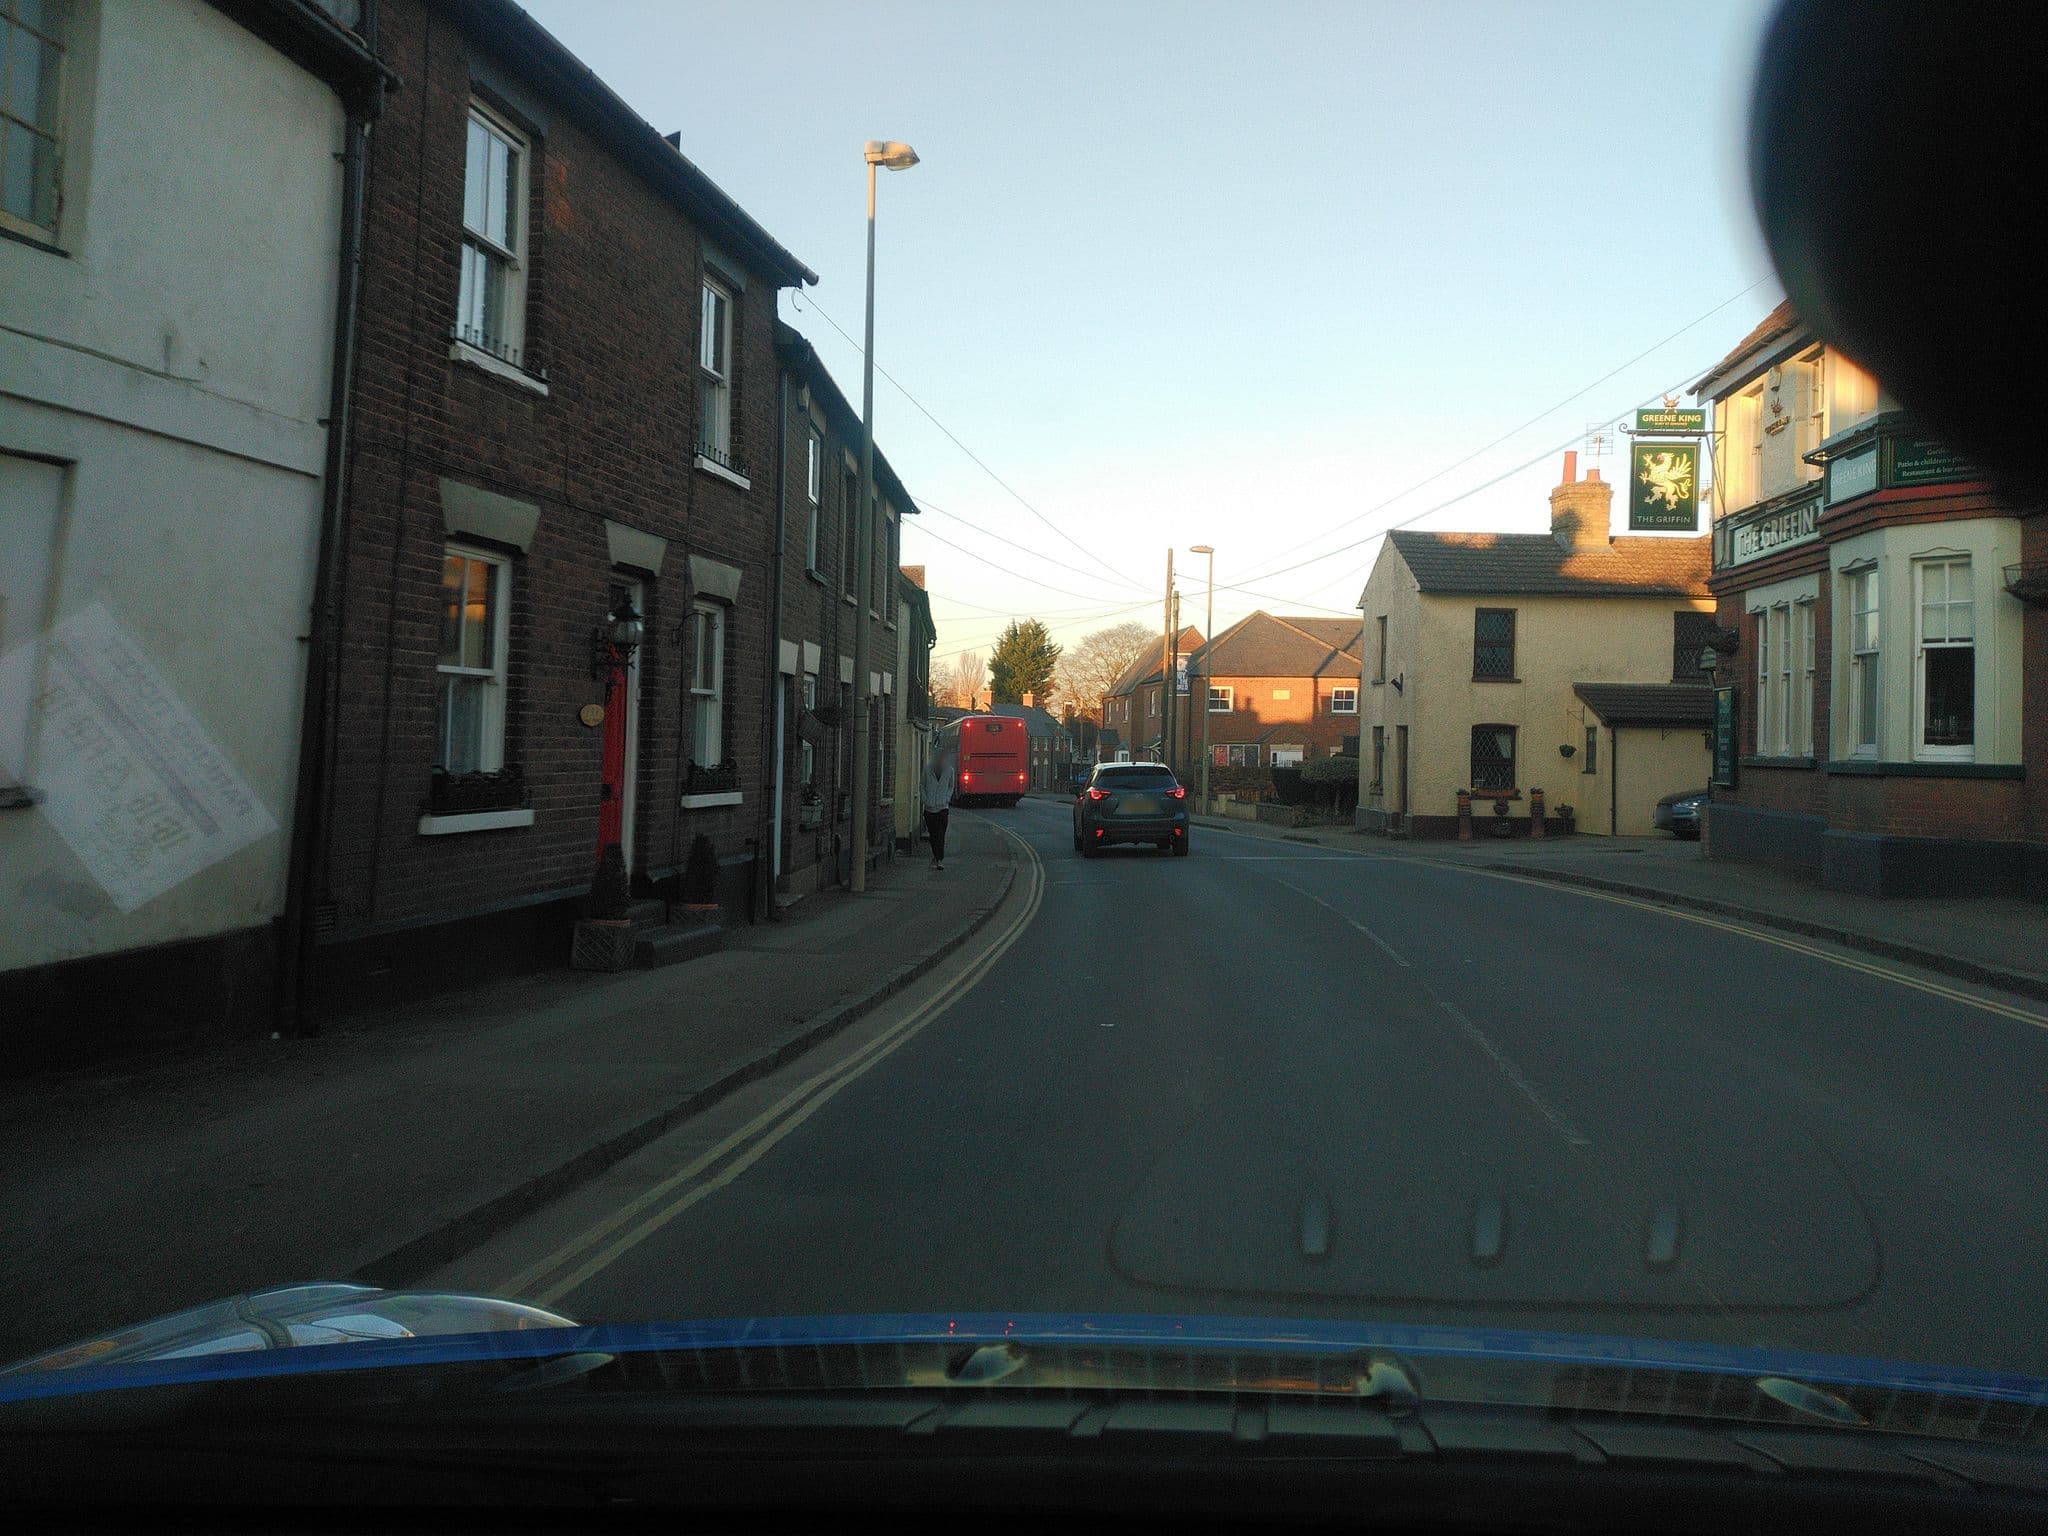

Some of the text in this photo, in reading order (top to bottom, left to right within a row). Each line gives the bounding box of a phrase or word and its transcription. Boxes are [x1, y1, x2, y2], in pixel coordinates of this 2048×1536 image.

[1642, 414, 1702, 422] GREENE KING
[1739, 505, 1815, 556] THE GRIFFIN
